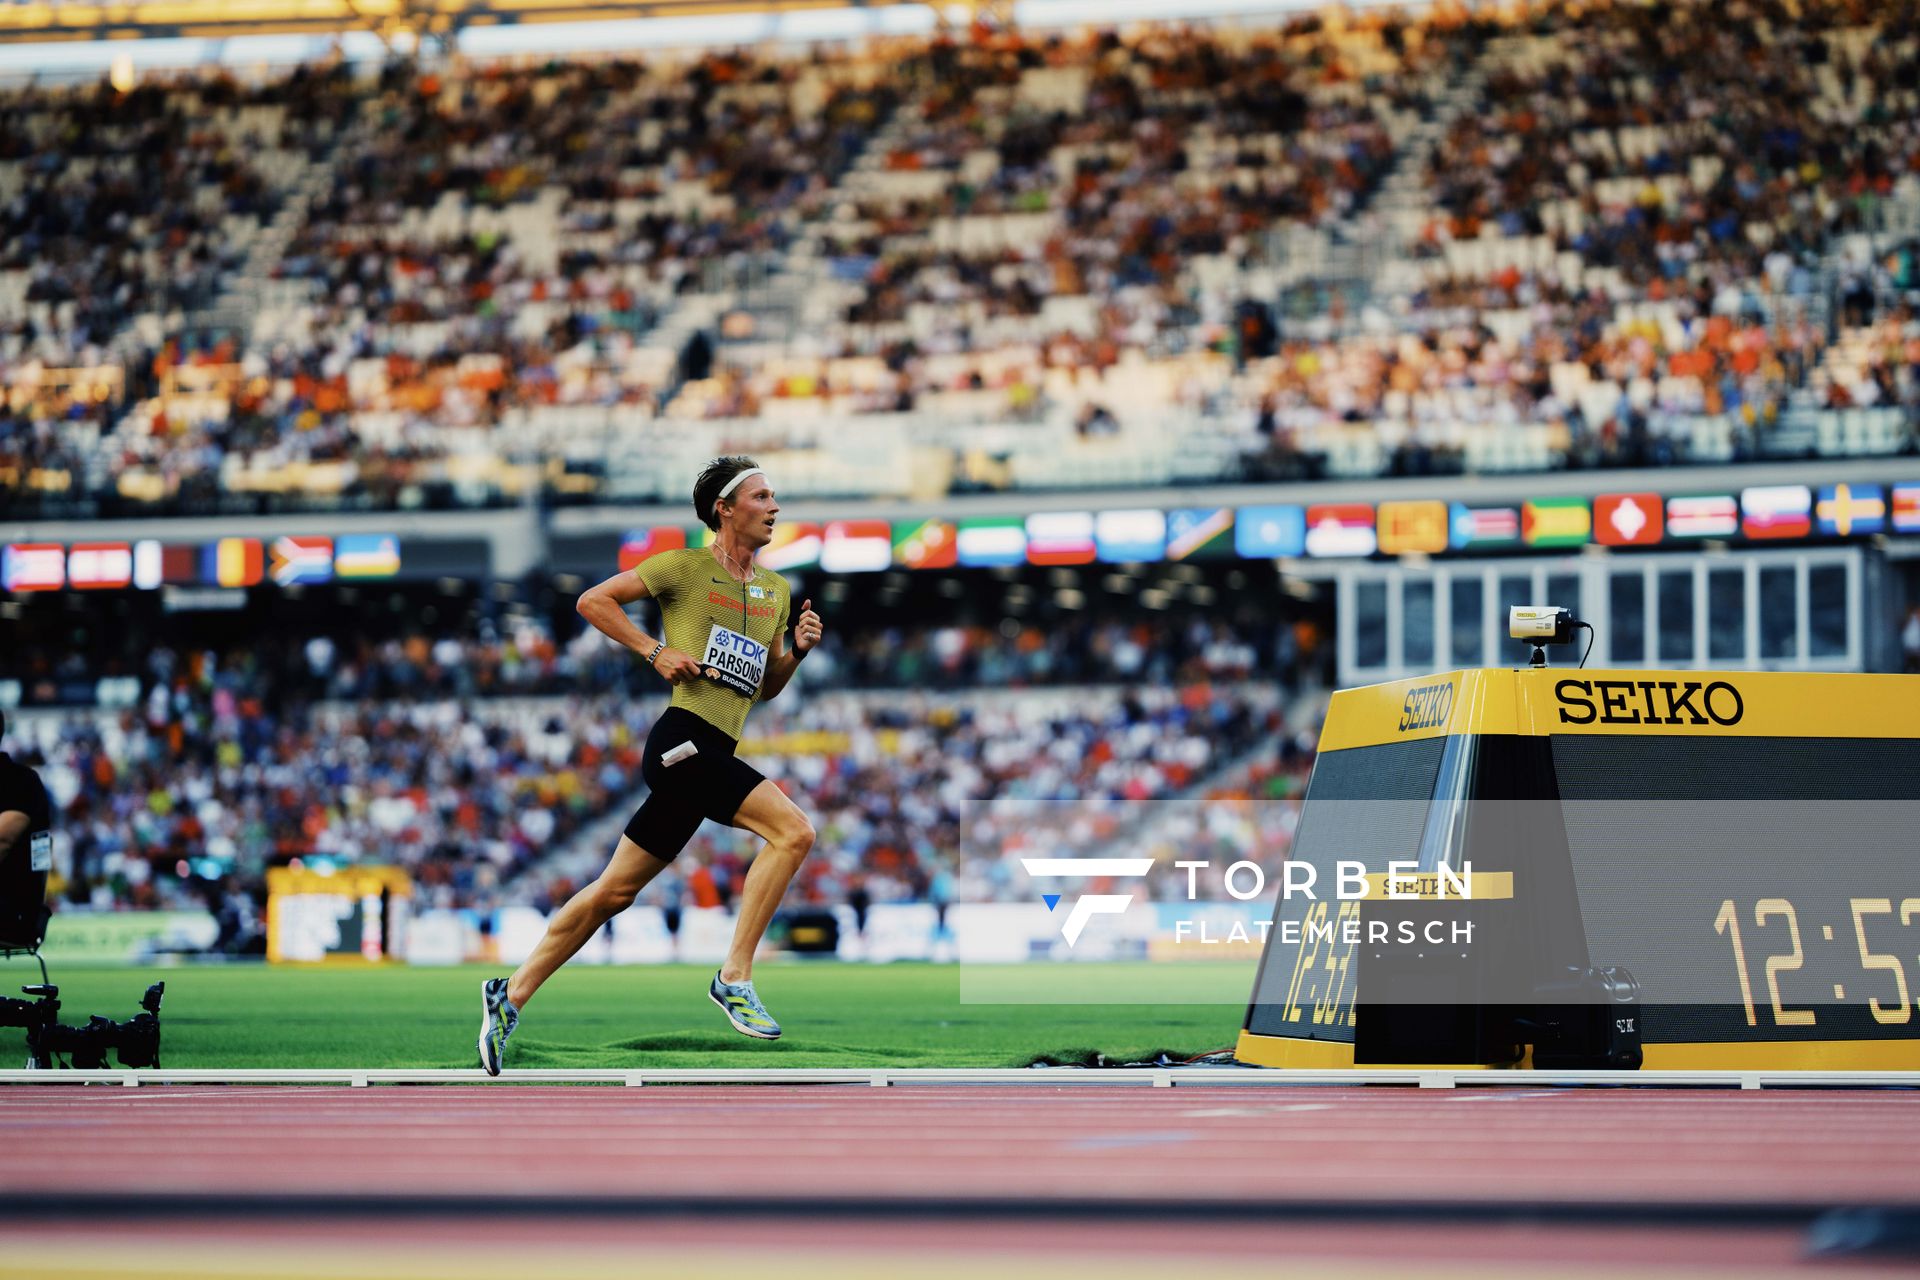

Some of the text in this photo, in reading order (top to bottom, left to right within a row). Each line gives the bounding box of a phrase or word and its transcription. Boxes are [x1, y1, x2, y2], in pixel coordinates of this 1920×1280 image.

[708, 591, 777, 619] GERMANY
[707, 647, 762, 684] PARSONS
[730, 633, 766, 665] TDK
[722, 674, 750, 693] BUDAPEST
[1398, 681, 1453, 732] SEIKO
[1555, 679, 1744, 726] SEIKO
